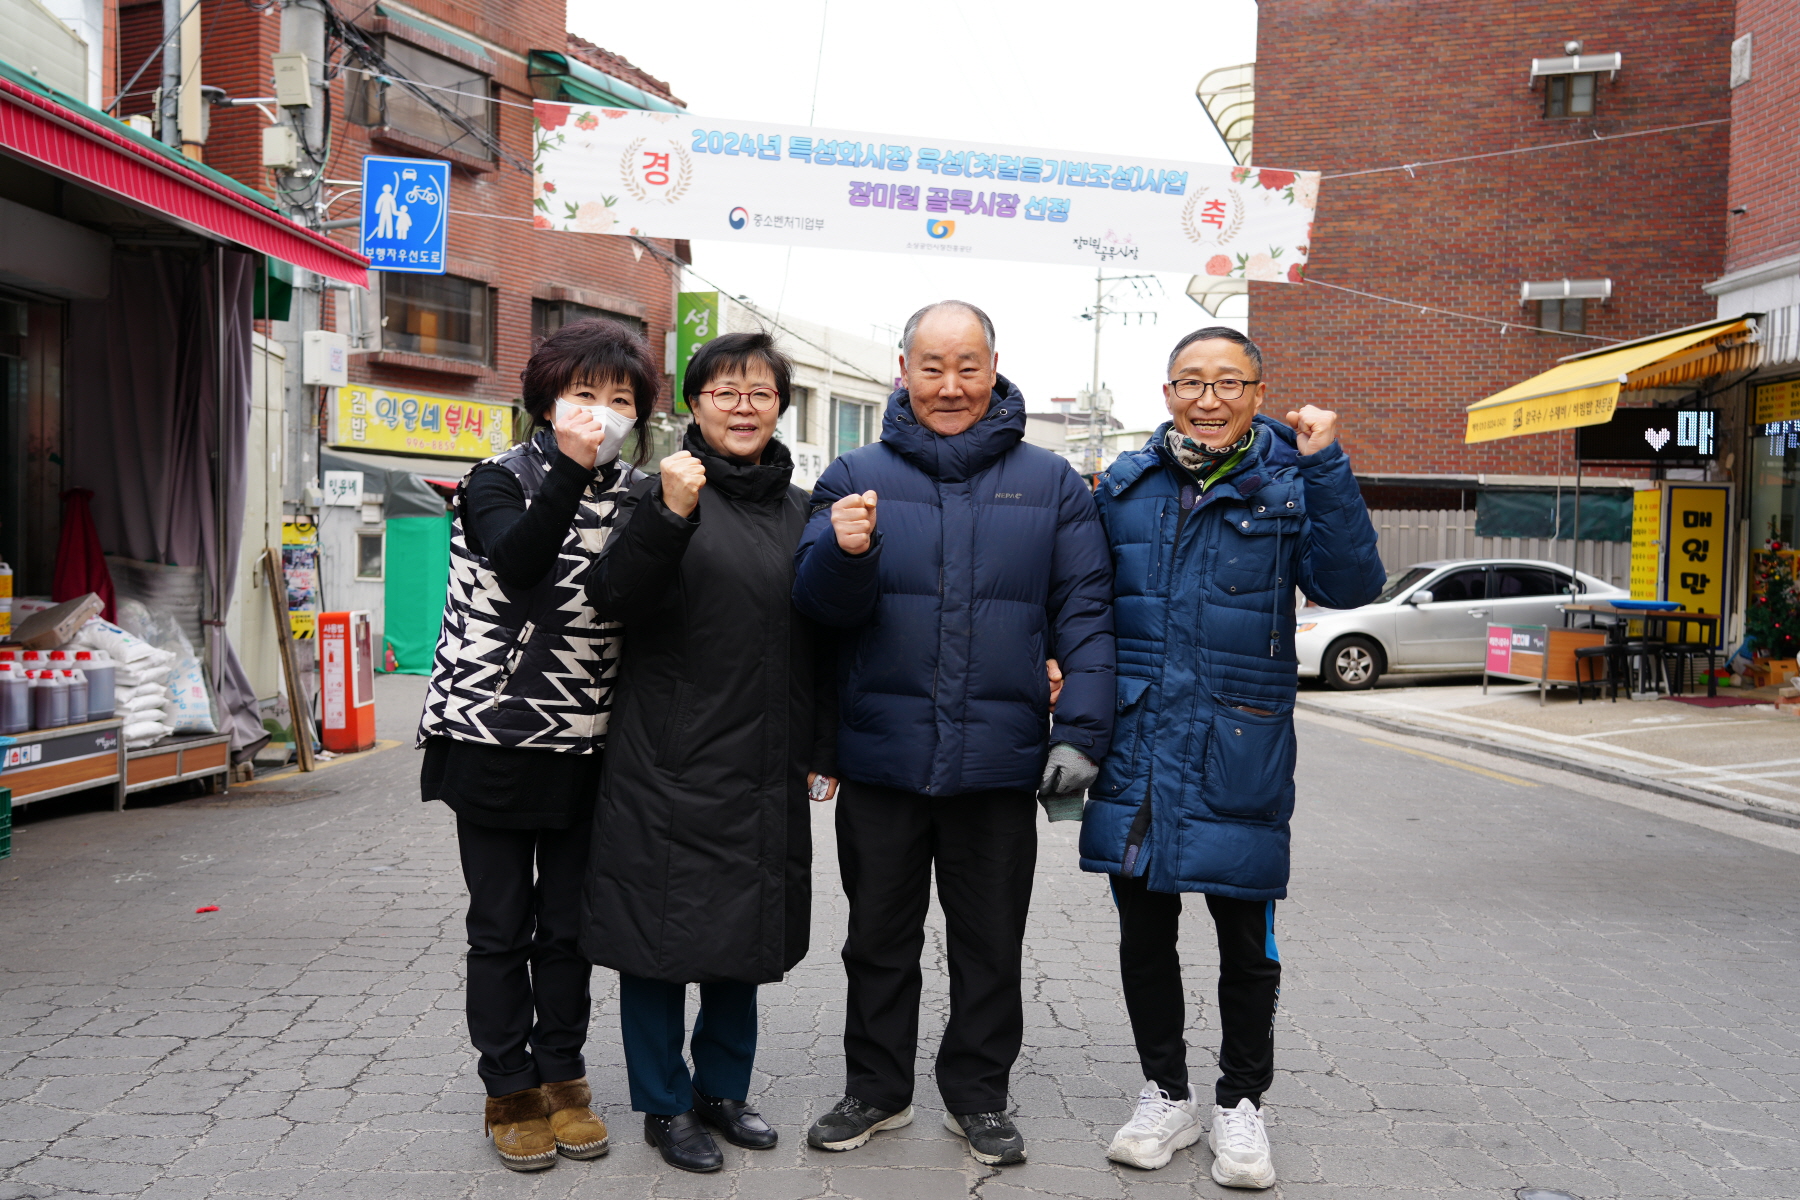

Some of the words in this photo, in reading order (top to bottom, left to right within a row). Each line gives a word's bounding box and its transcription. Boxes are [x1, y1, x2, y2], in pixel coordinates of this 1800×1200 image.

[691, 129, 781, 161] 2024년
[788, 136, 913, 172] 특성화시장
[643, 152, 669, 186] 경
[848, 181, 920, 211] 장미원
[926, 187, 1020, 218] 골목시장
[1024, 196, 1071, 223] 선정
[1201, 199, 1227, 229] 축
[753, 213, 825, 231] 중소벤처기업부
[366, 247, 441, 263] 보행자우선도로
[351, 391, 367, 441] 김밥
[445, 404, 484, 438] 분식
[1525, 410, 1542, 425] 칼국수
[1573, 401, 1593, 417] 비빔밥
[406, 437, 456, 452] 996-8859
